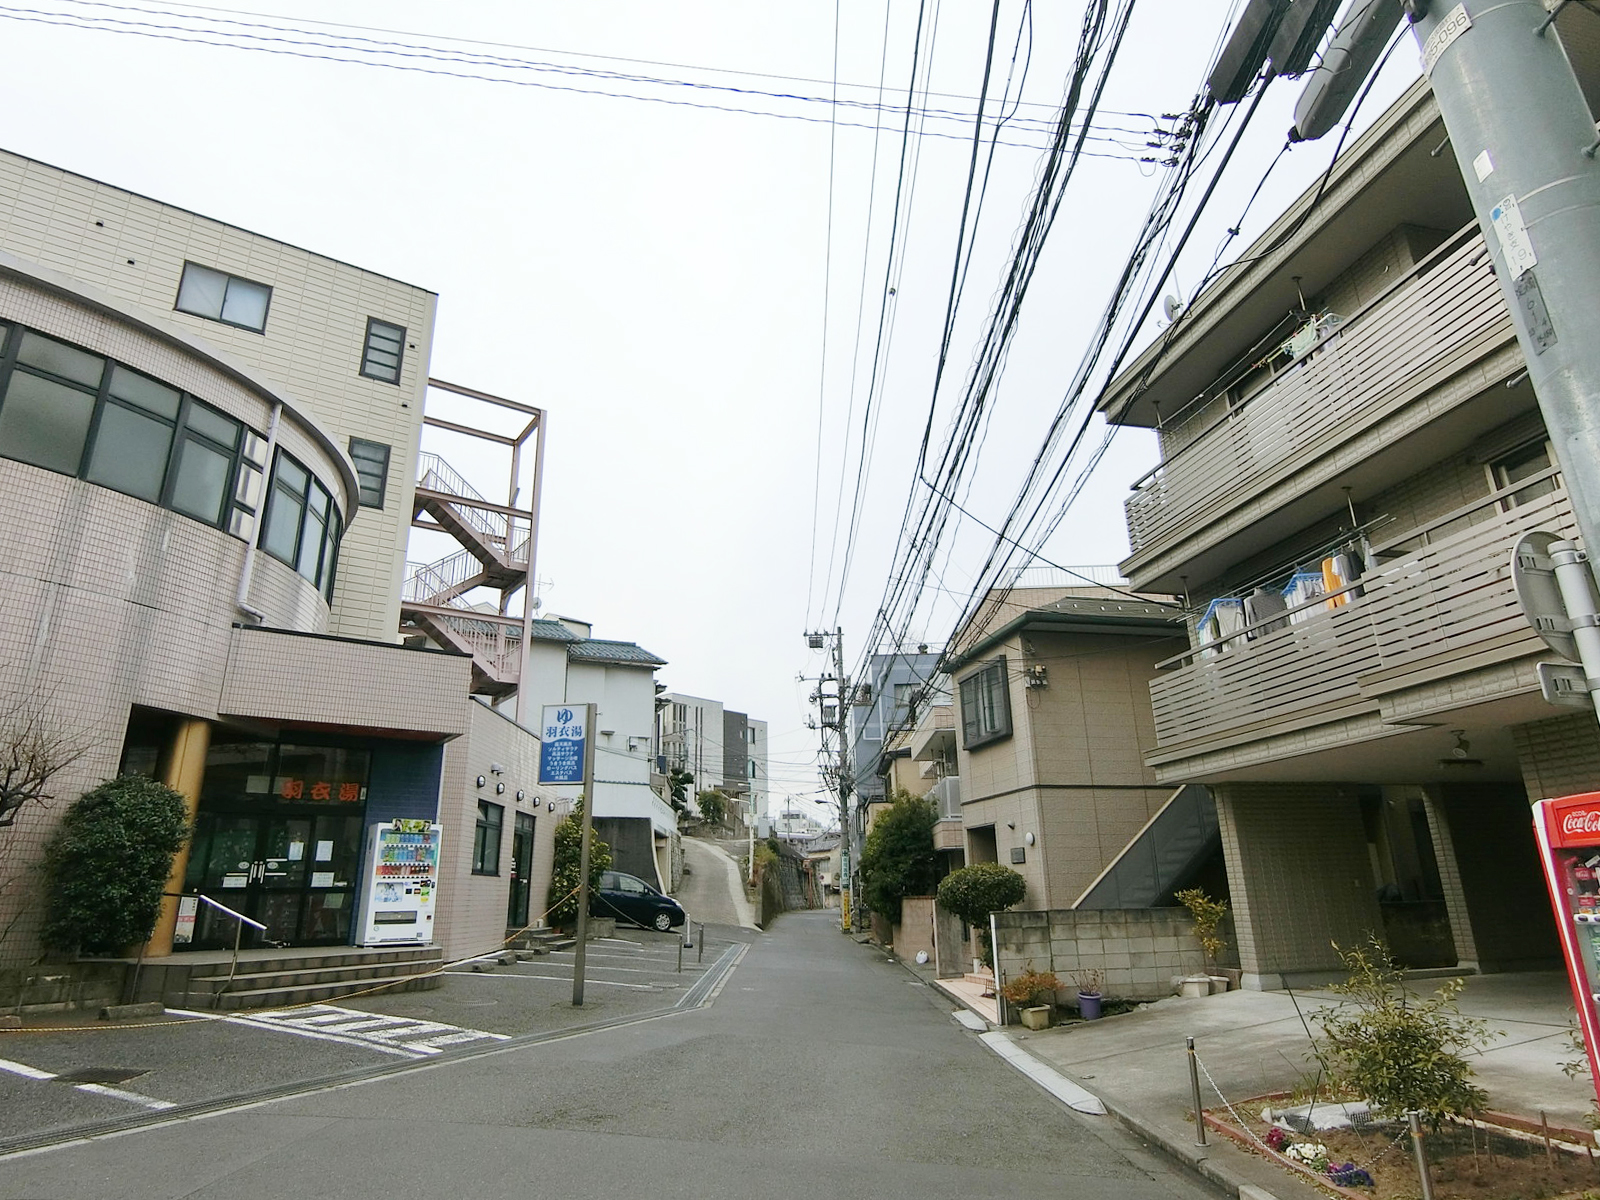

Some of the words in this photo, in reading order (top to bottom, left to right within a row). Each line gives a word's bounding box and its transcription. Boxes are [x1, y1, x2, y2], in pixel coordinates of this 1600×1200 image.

[557, 709, 573, 724] ゆ
[546, 726, 582, 737] 羽衣湯
[281, 780, 358, 801] 羽衣湯
